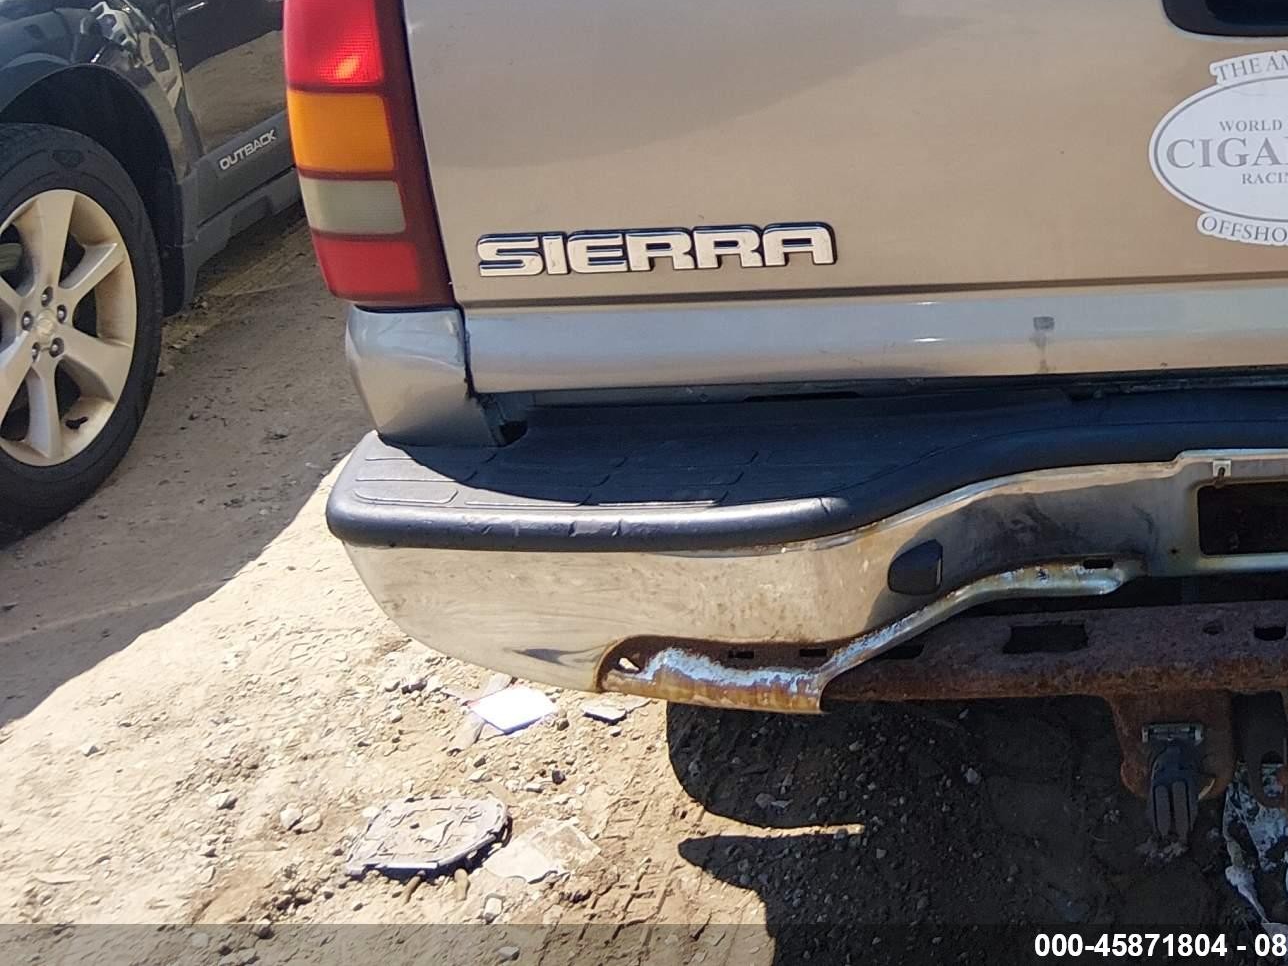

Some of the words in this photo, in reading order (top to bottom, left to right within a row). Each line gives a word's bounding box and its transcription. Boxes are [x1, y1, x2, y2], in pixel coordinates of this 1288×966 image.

[1214, 58, 1262, 82] THE
[1219, 119, 1283, 133] WORLD
[219, 129, 277, 170] OUTBACK
[476, 221, 837, 277] SIERRA
